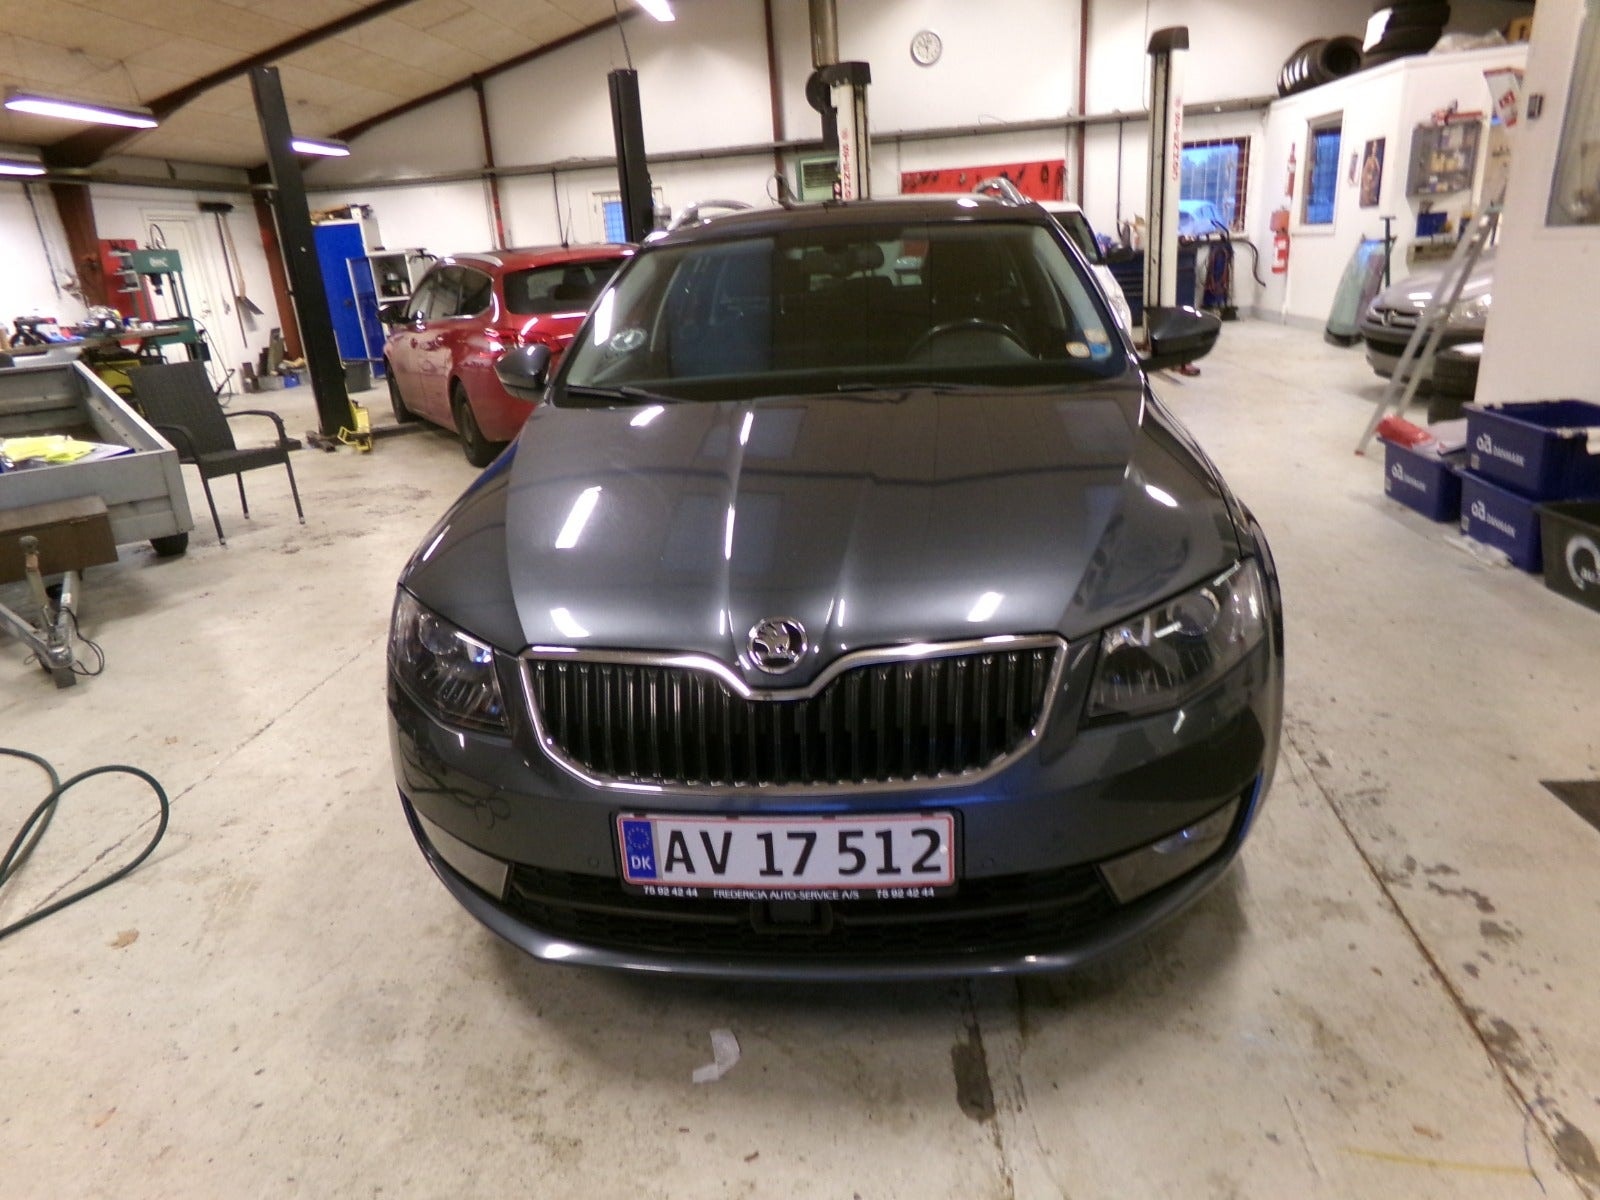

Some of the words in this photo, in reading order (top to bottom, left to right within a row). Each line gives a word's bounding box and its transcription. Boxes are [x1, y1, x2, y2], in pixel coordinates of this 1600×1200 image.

[1493, 445, 1525, 468] DANMARK
[1486, 512, 1517, 539] DANMARK
[630, 854, 652, 870] DK
[664, 829, 733, 875] AV
[756, 831, 818, 877] 17
[838, 828, 942, 876] 512
[713, 889, 768, 900] FREDERICIA
